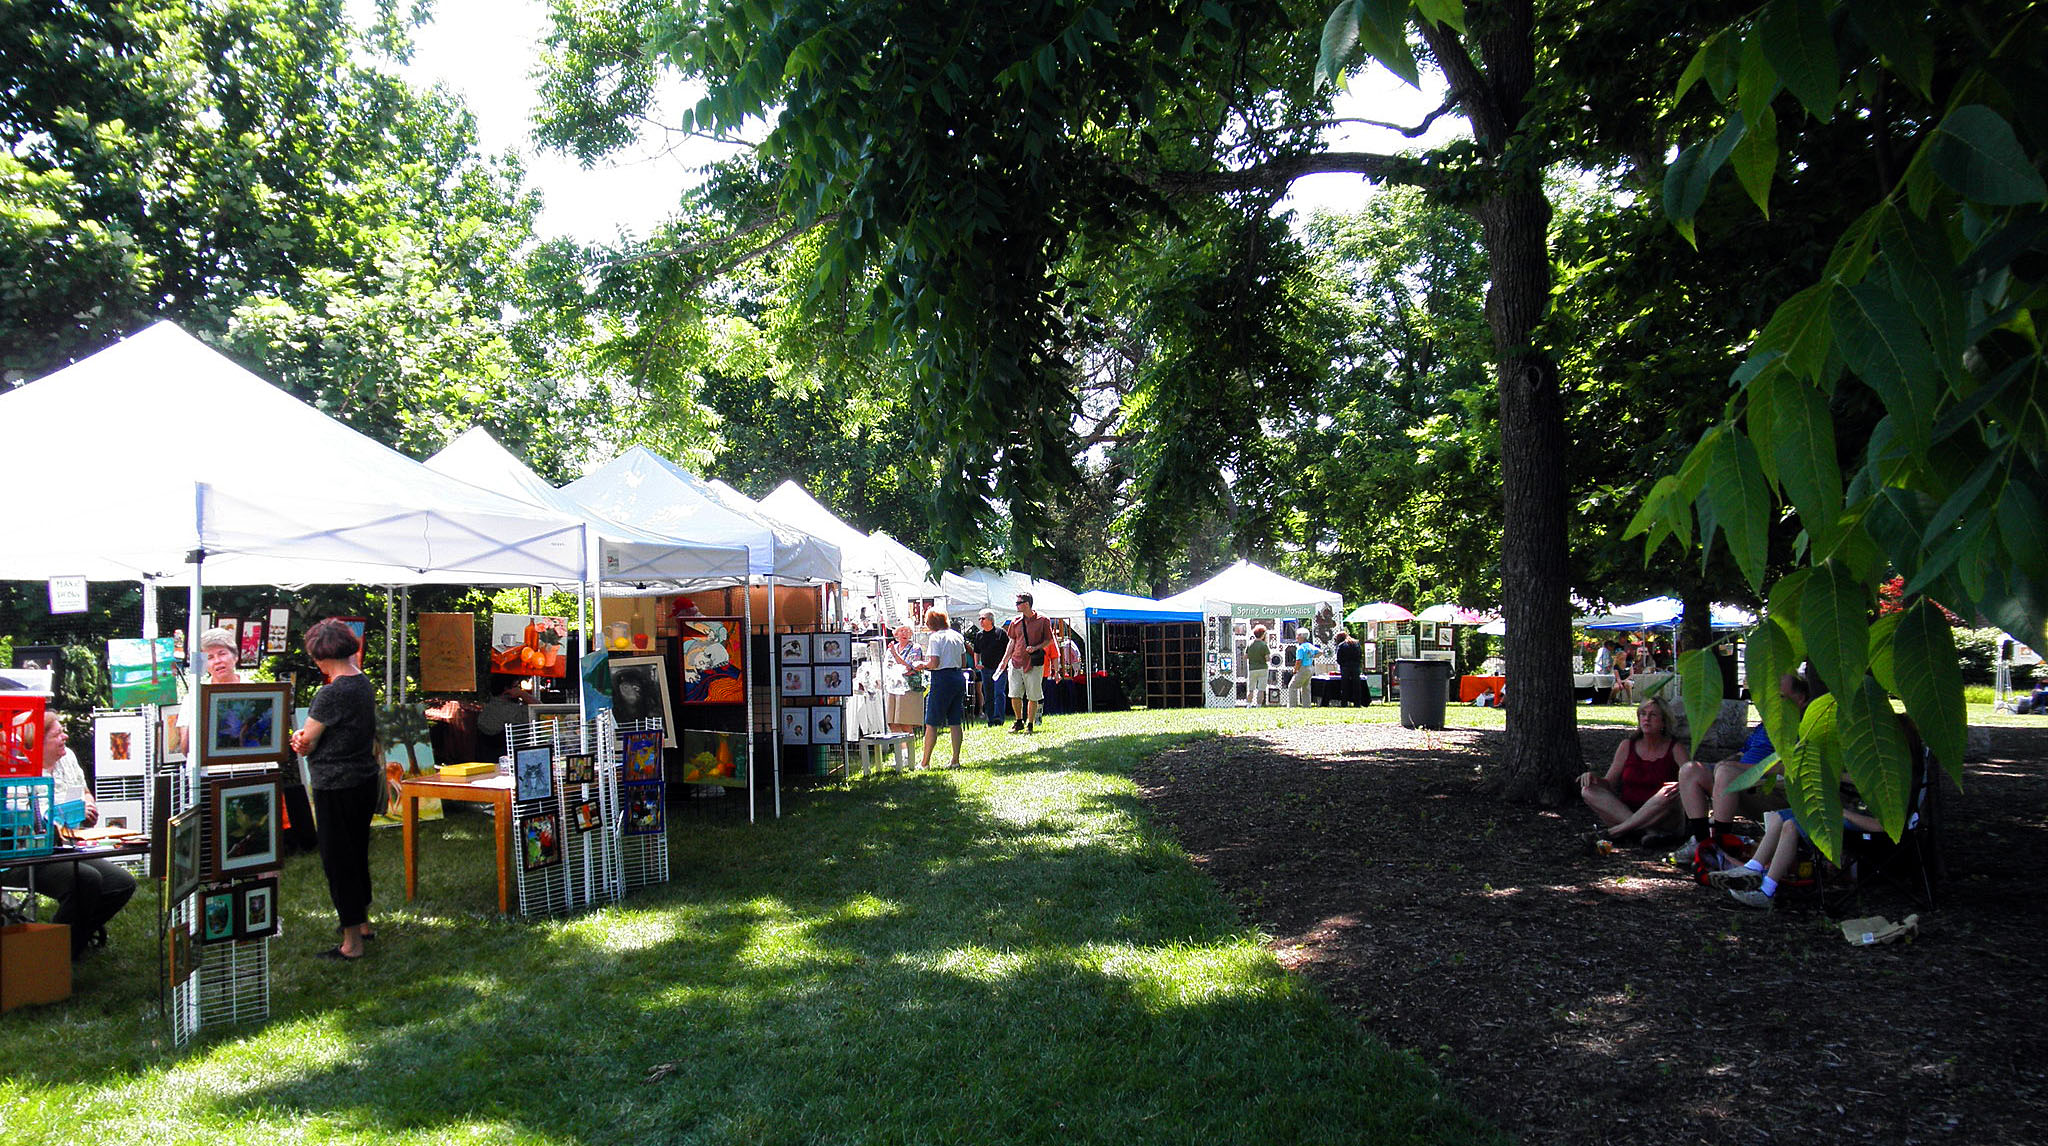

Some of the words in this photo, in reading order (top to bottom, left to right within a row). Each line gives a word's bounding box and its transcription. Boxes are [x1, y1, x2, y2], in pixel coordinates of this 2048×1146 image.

[1237, 606, 1260, 617] Spring
[1261, 606, 1281, 615] Grove
[1284, 606, 1312, 615] Mosaics
